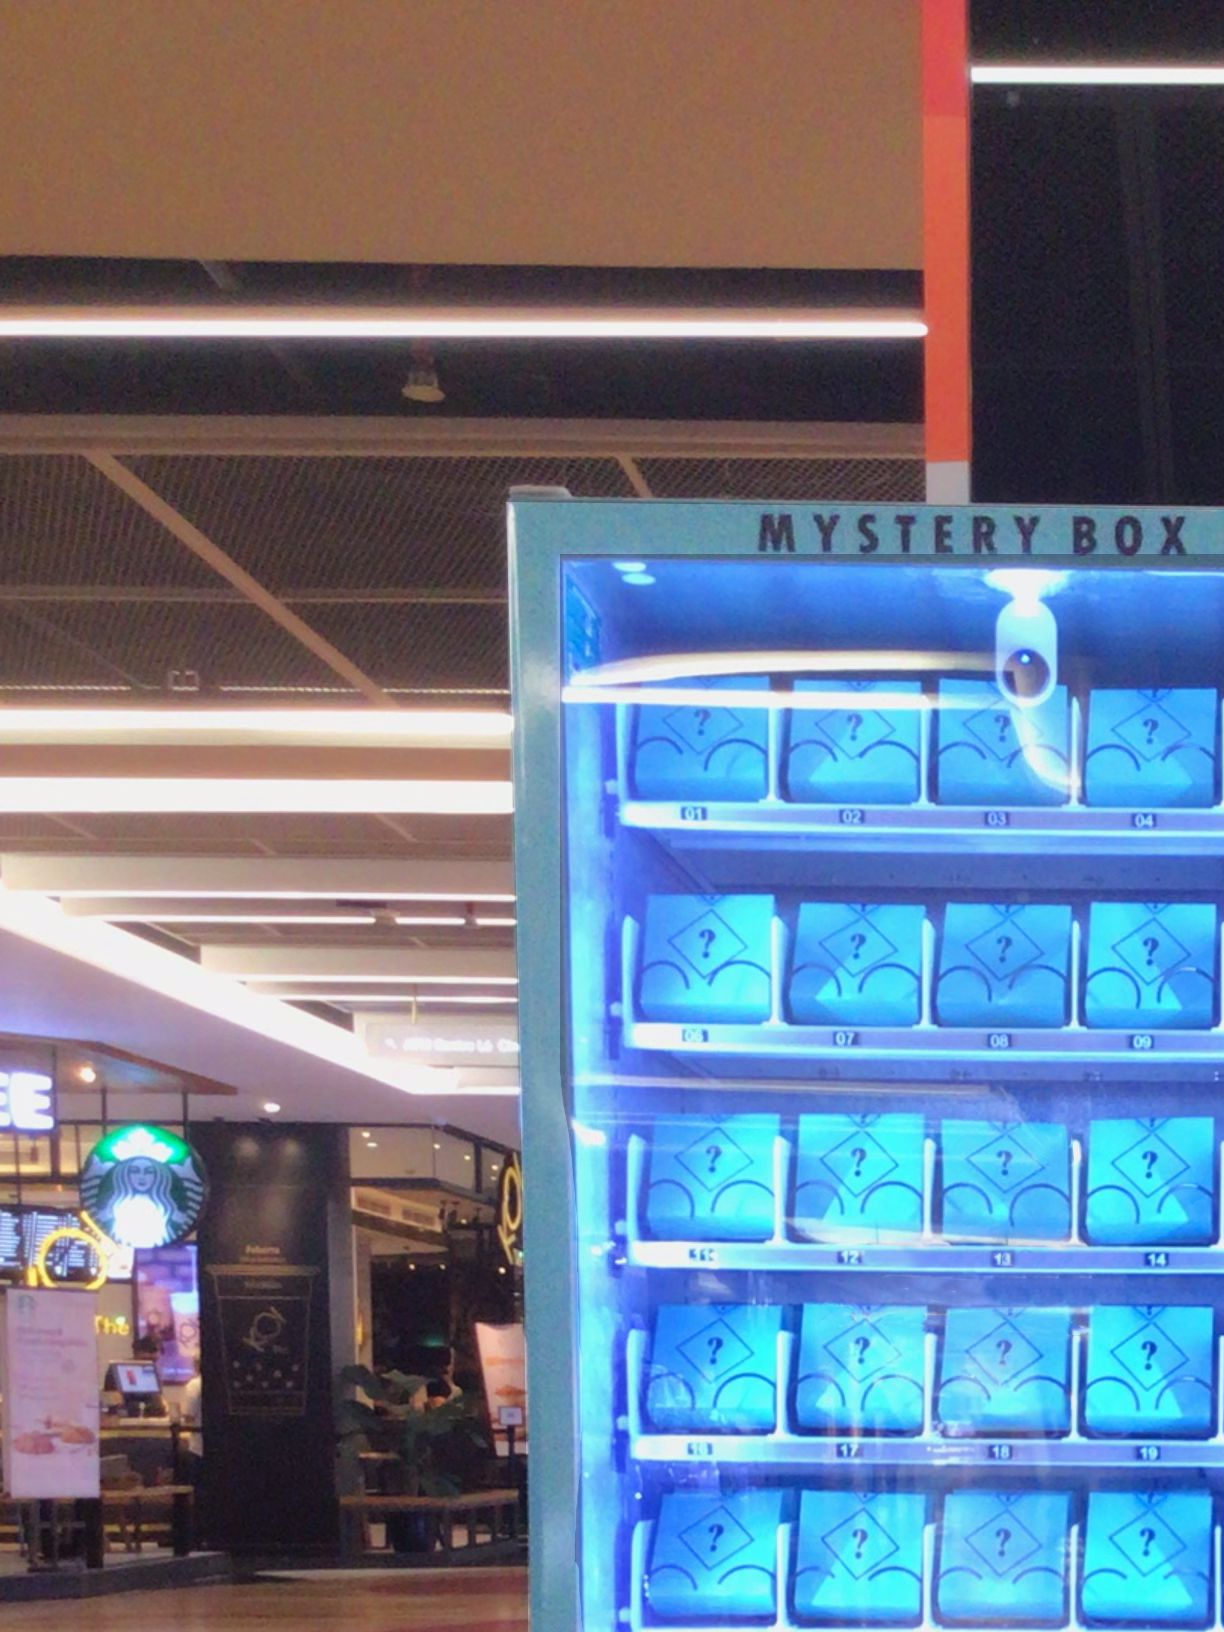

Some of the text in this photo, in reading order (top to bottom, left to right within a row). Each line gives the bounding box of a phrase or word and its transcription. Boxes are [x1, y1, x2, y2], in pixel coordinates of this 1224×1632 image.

[757, 512, 1188, 557] MYSTERY BOX
[685, 807, 703, 821] 01
[842, 809, 862, 823] 02
[987, 812, 1007, 826] 03
[1134, 813, 1154, 828] 04
[835, 1032, 855, 1046] 07
[989, 1034, 1009, 1048] 08
[1132, 1034, 1152, 1049] 09
[840, 1249, 860, 1264] 12
[993, 1251, 1013, 1267] 13
[1147, 1252, 1167, 1267] 14
[840, 1443, 859, 1457] 17
[991, 1444, 1010, 1459] 18
[1139, 1445, 1158, 1460] 19
